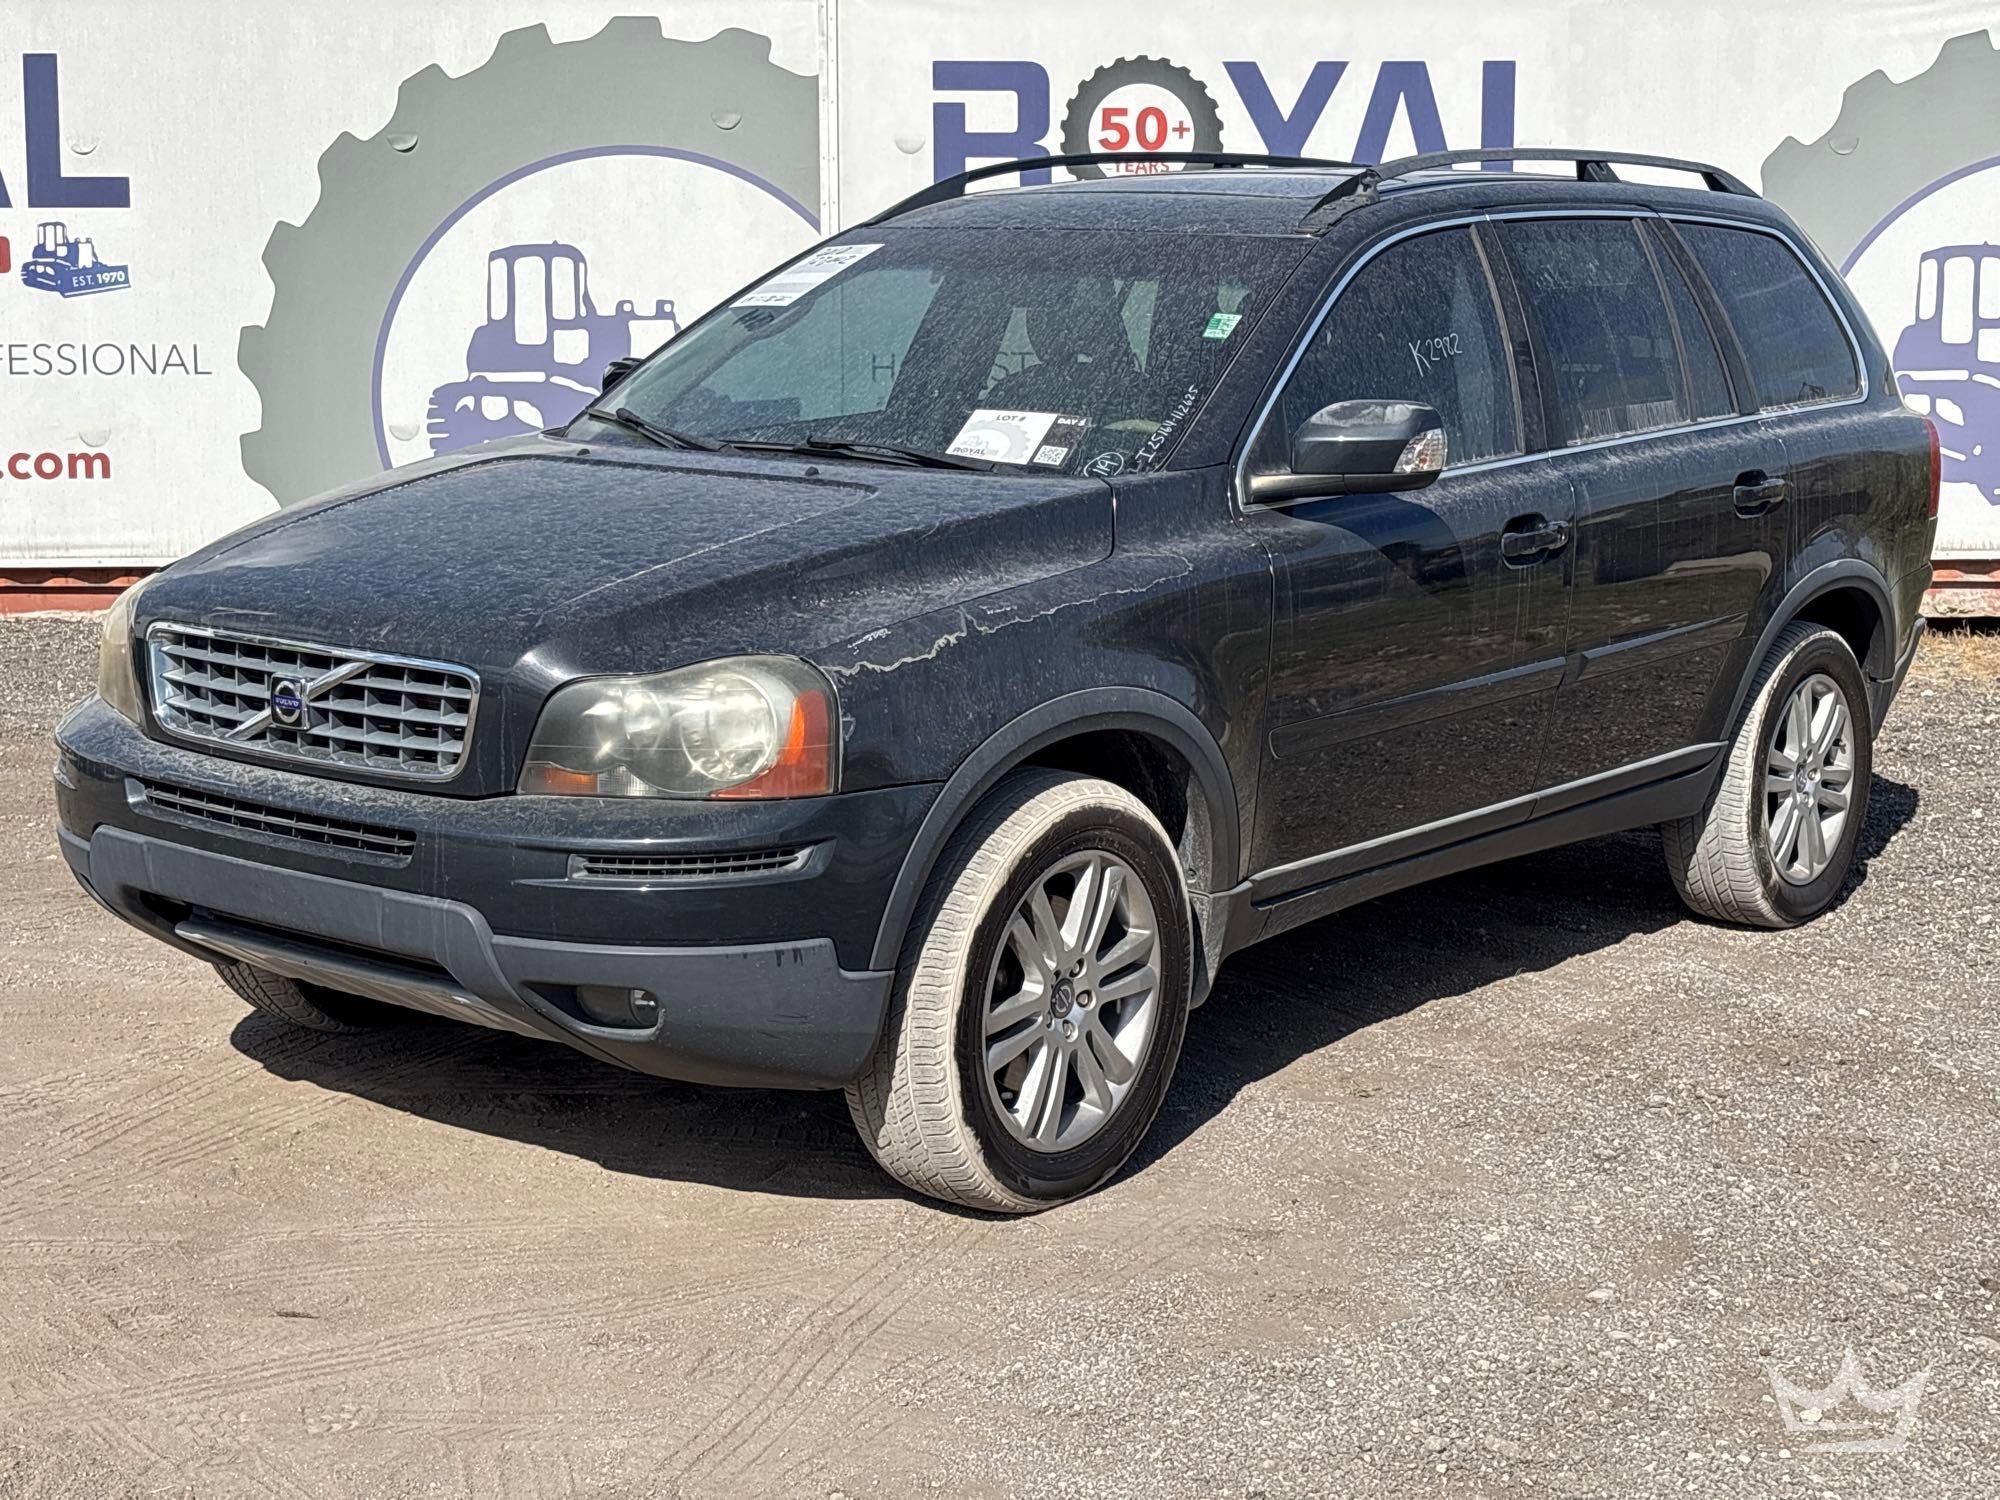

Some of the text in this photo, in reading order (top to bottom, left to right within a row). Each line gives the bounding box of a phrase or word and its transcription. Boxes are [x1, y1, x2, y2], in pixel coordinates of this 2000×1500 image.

[0, 53, 130, 208] L
[1098, 107, 1190, 151] 50+
[72, 271, 126, 287] EST. 1970
[0, 343, 212, 375] ESSIONAL
[1408, 332, 1463, 378] K2982
[1057, 417, 1079, 426] DAY
[952, 447, 986, 456] ROYAL
